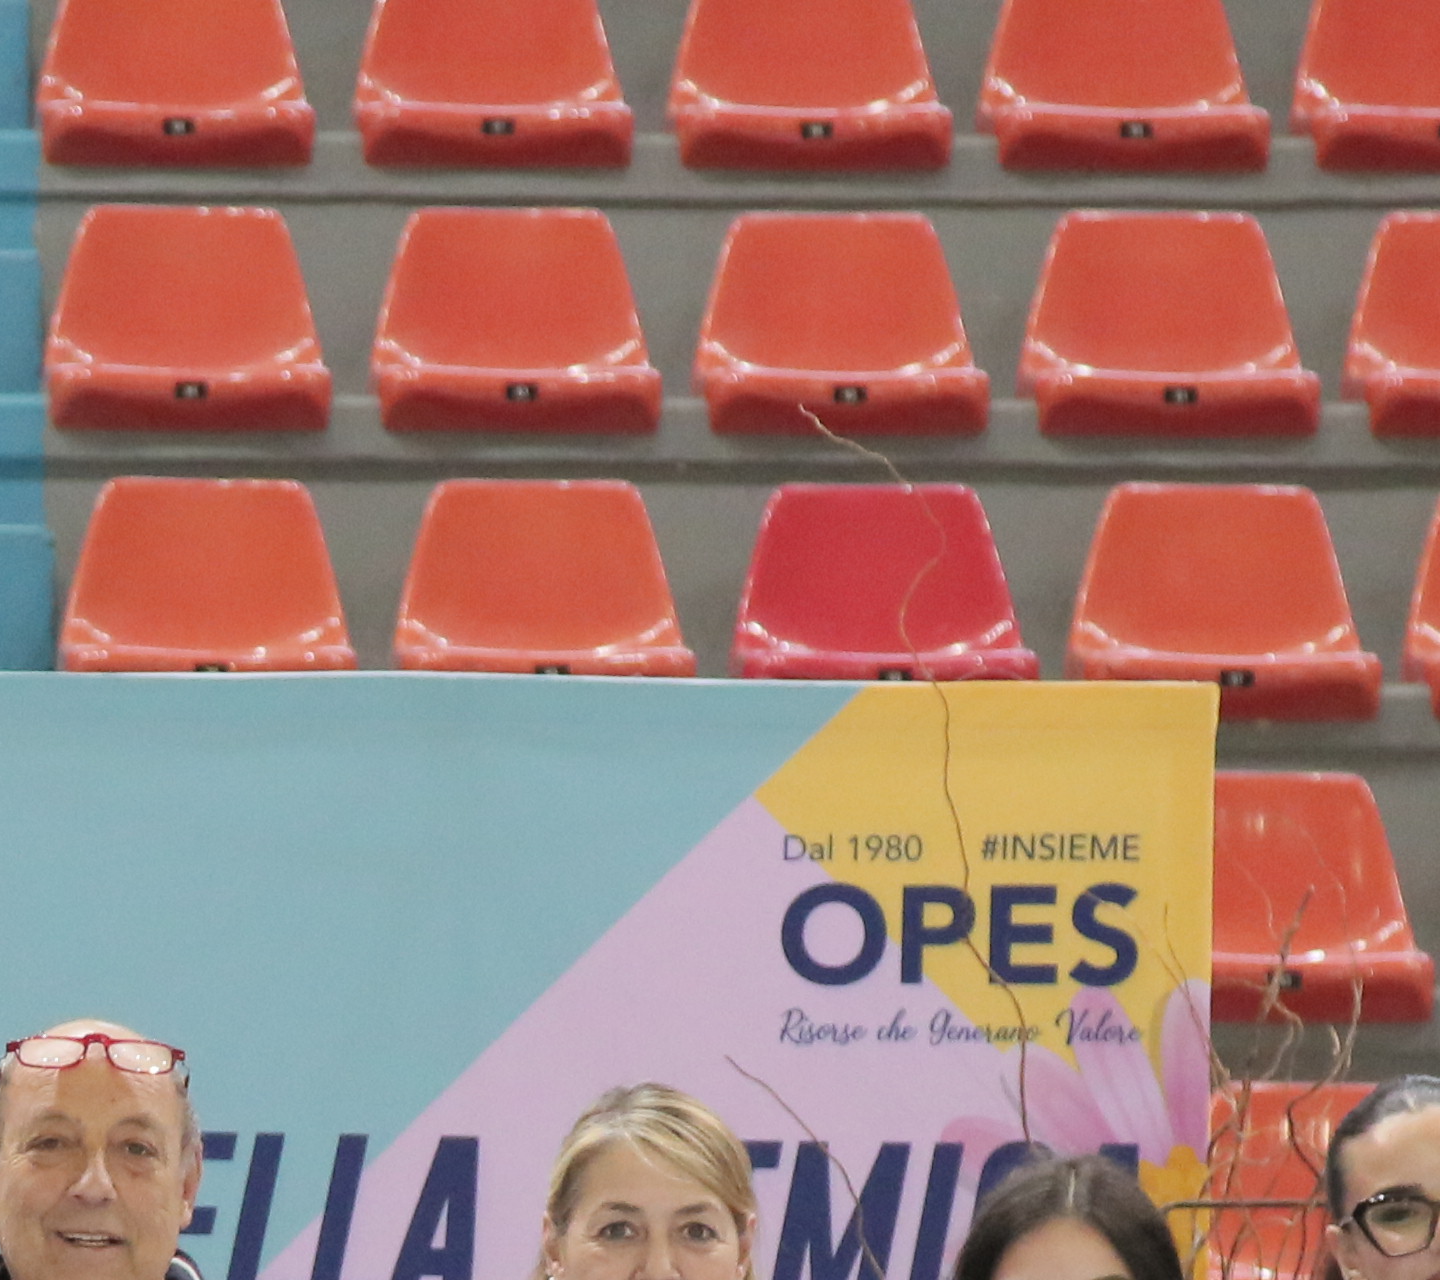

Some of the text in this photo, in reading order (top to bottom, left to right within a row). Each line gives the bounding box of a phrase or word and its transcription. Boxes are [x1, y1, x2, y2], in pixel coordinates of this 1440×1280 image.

[783, 834, 1140, 862] Dal 1980 #INSIEME
[781, 882, 1139, 986] OPES
[779, 1008, 1141, 1046] Risorse che Generano Valore
